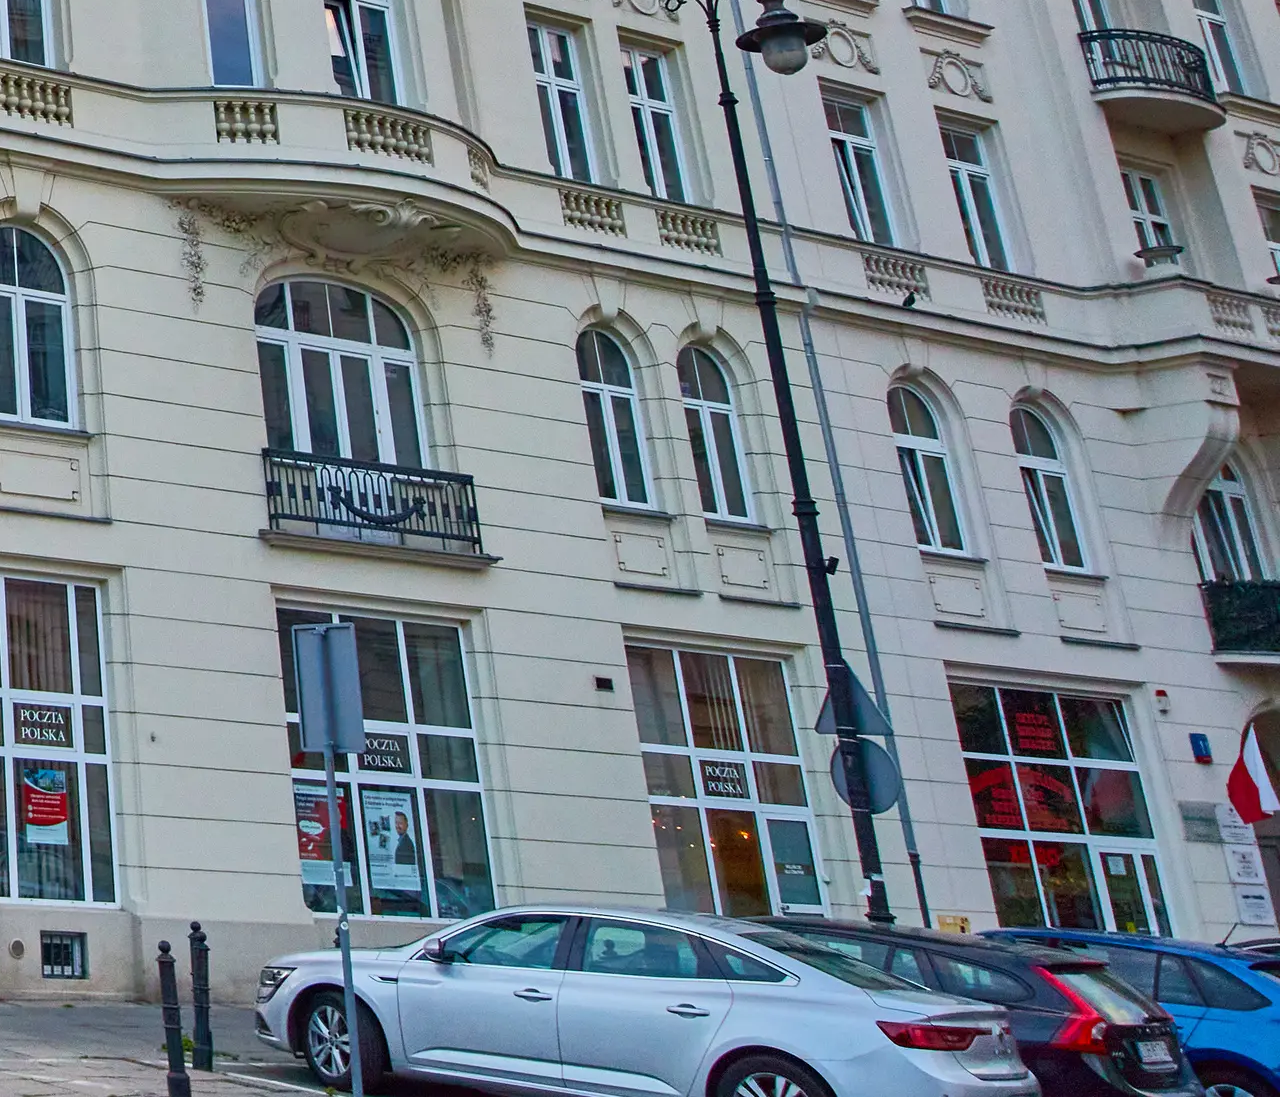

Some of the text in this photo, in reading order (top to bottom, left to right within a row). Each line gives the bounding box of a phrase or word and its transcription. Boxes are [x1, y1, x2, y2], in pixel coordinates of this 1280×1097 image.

[20, 709, 64, 724] POCZTA
[21, 726, 66, 742] POLSKA
[363, 754, 403, 768] POLSKA
[704, 765, 740, 779] POCZTA
[707, 780, 743, 794] POLSKA
